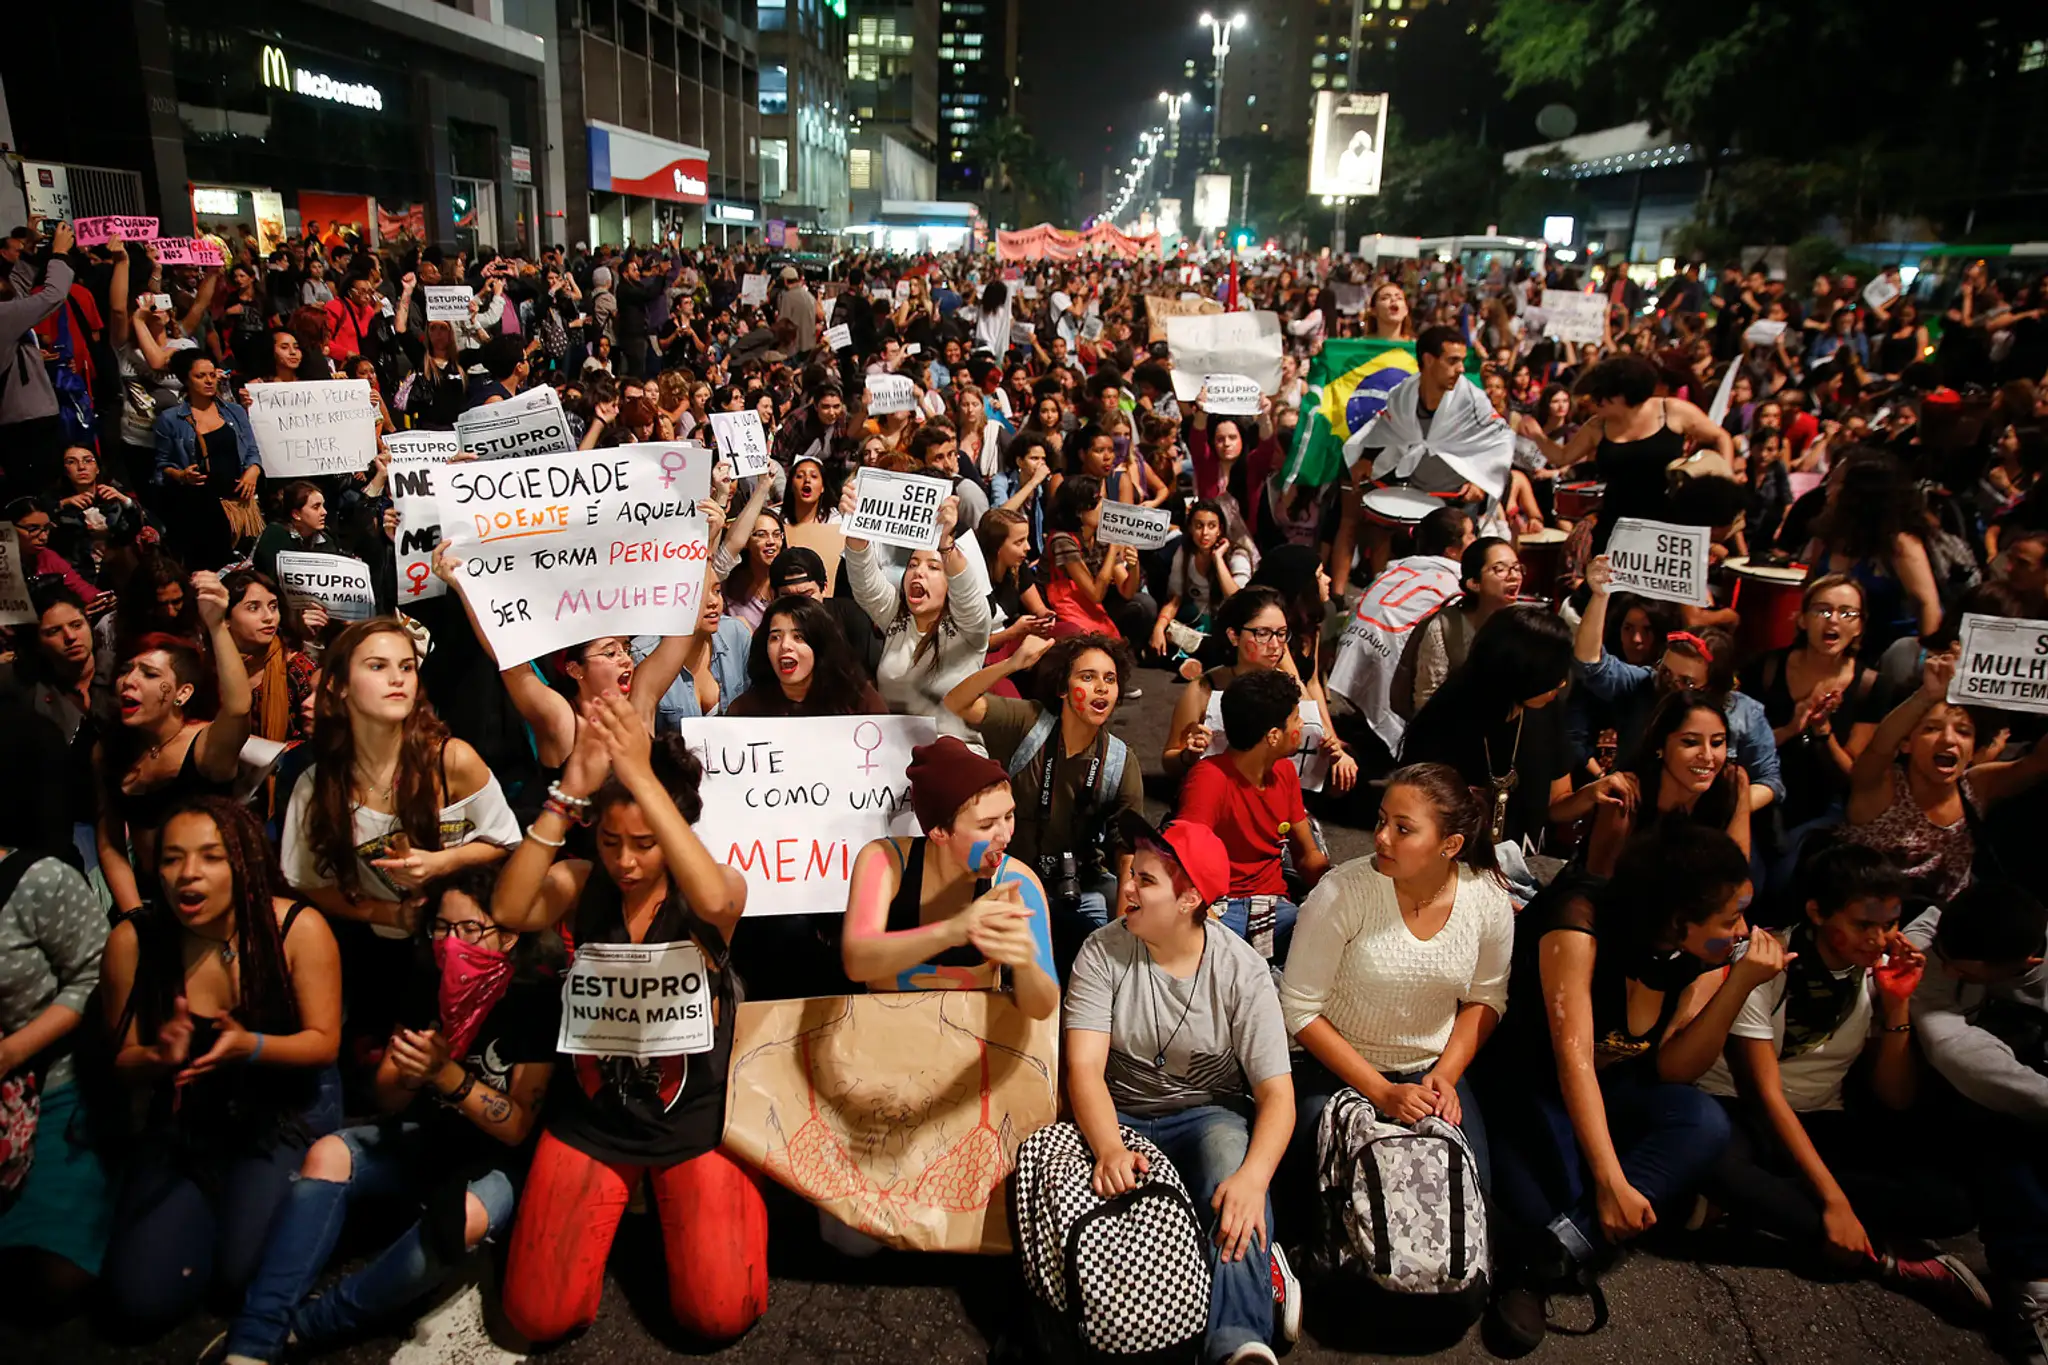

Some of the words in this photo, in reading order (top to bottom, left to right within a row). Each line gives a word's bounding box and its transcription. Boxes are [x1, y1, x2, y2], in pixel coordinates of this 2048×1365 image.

[428, 295, 471, 303] ESTUPRO
[1207, 385, 1258, 394] ESTUPRO
[278, 436, 340, 462] TEMER
[390, 442, 457, 454] ESTUPRO
[463, 425, 561, 456] ESTUPRO
[451, 460, 631, 503] SOCIEDADE
[902, 484, 937, 505] SER
[474, 504, 569, 538] DOENTE
[586, 499, 601, 526] É
[616, 499, 697, 526] AQUELA
[860, 497, 934, 525] MULHER
[1103, 512, 1164, 532] ESTUPRO
[854, 515, 882, 531] SEM
[885, 521, 930, 540] TEMER!
[1102, 523, 1134, 536] NUNCA
[1136, 531, 1162, 541] MAIS!
[1657, 534, 1692, 557] SER
[467, 554, 515, 578] QUE
[530, 547, 598, 570] TORNA
[1611, 550, 1692, 579] MULHER
[283, 572, 366, 589] ESTUPRO
[1641, 576, 1692, 595] TEMER!
[490, 598, 532, 627] SER
[554, 580, 700, 622] MULHER!
[1967, 677, 2006, 695] SEM
[2010, 681, 2048, 700] TEM
[703, 738, 784, 776] LUTE
[1044, 757, 1053, 788] DIGITAL
[1086, 757, 1100, 787] Canon
[745, 782, 830, 808] COMO
[850, 786, 913, 812] UMA
[571, 972, 701, 999] ESTUPRO
[573, 1005, 641, 1024] NUNCA
[646, 1003, 703, 1024] MAIS!
